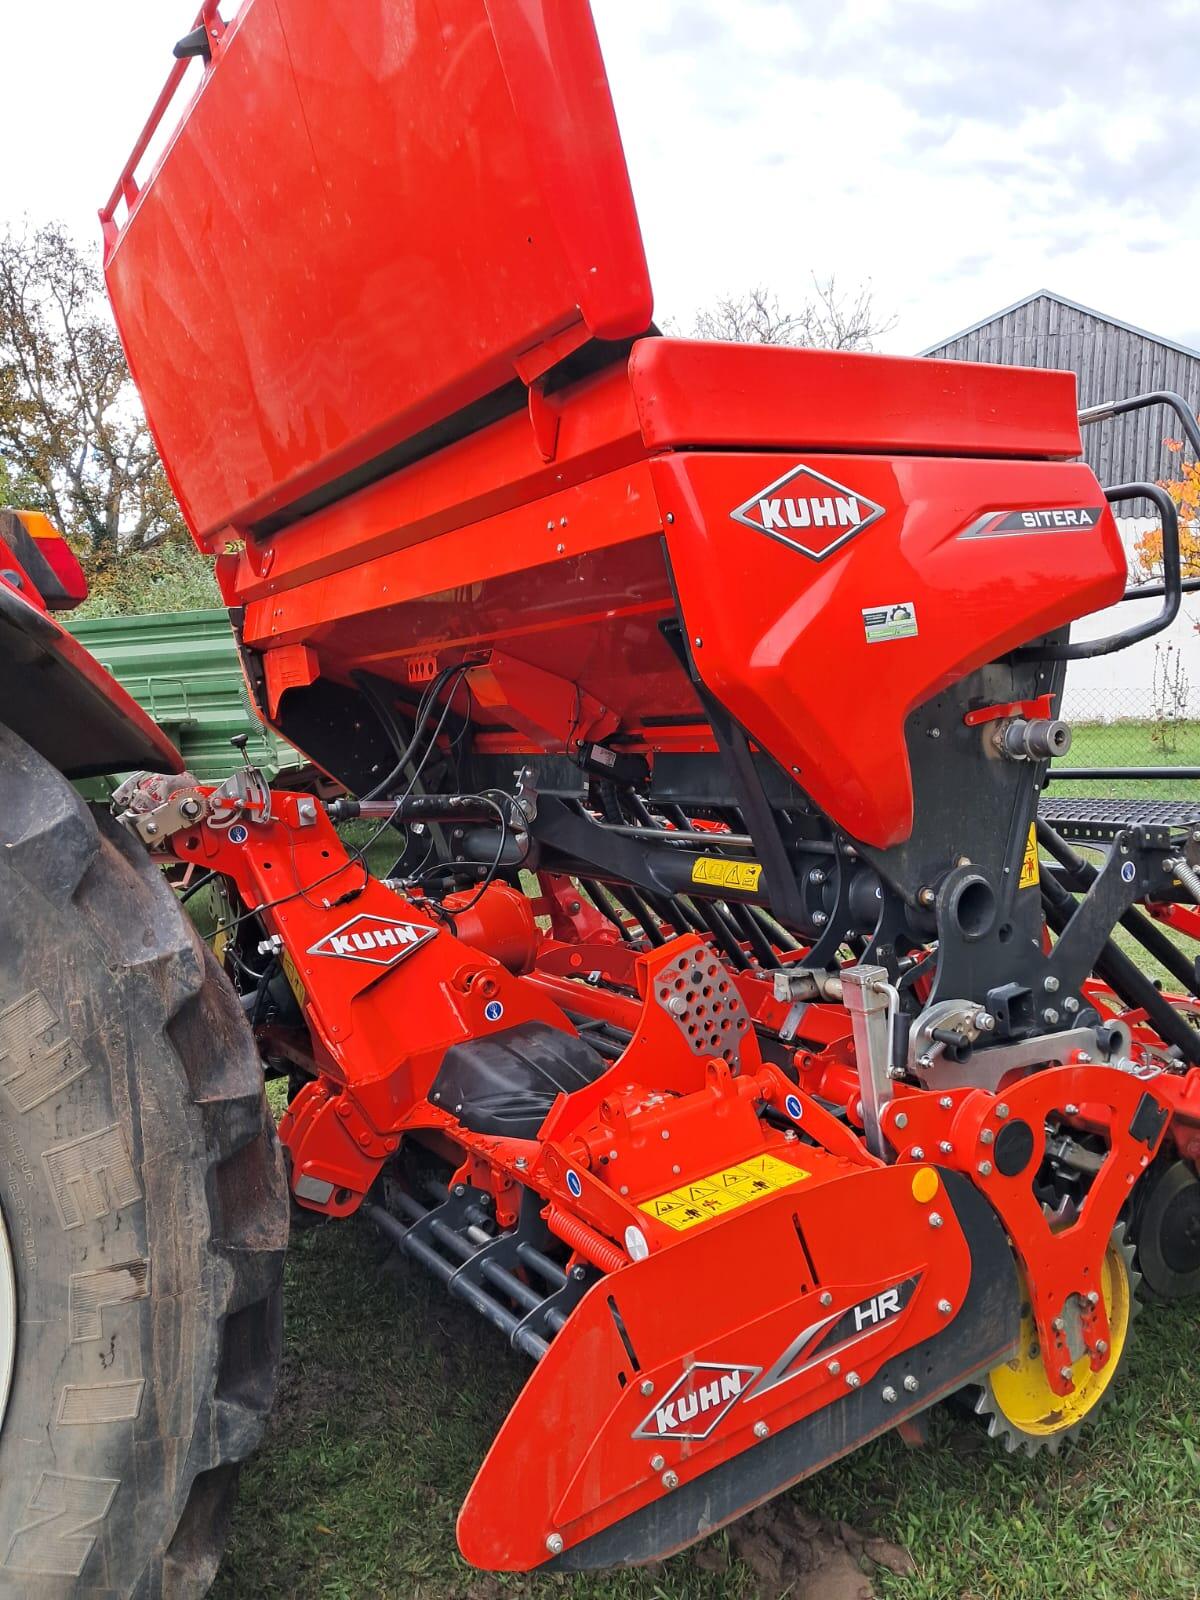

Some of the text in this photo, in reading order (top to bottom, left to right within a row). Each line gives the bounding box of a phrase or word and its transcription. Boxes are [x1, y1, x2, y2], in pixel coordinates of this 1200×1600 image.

[760, 497, 860, 528] KUHN
[1022, 510, 1093, 527] SITERA
[330, 926, 419, 954] KUHN
[856, 1288, 901, 1331] HR
[656, 1370, 742, 1434] KUHN
